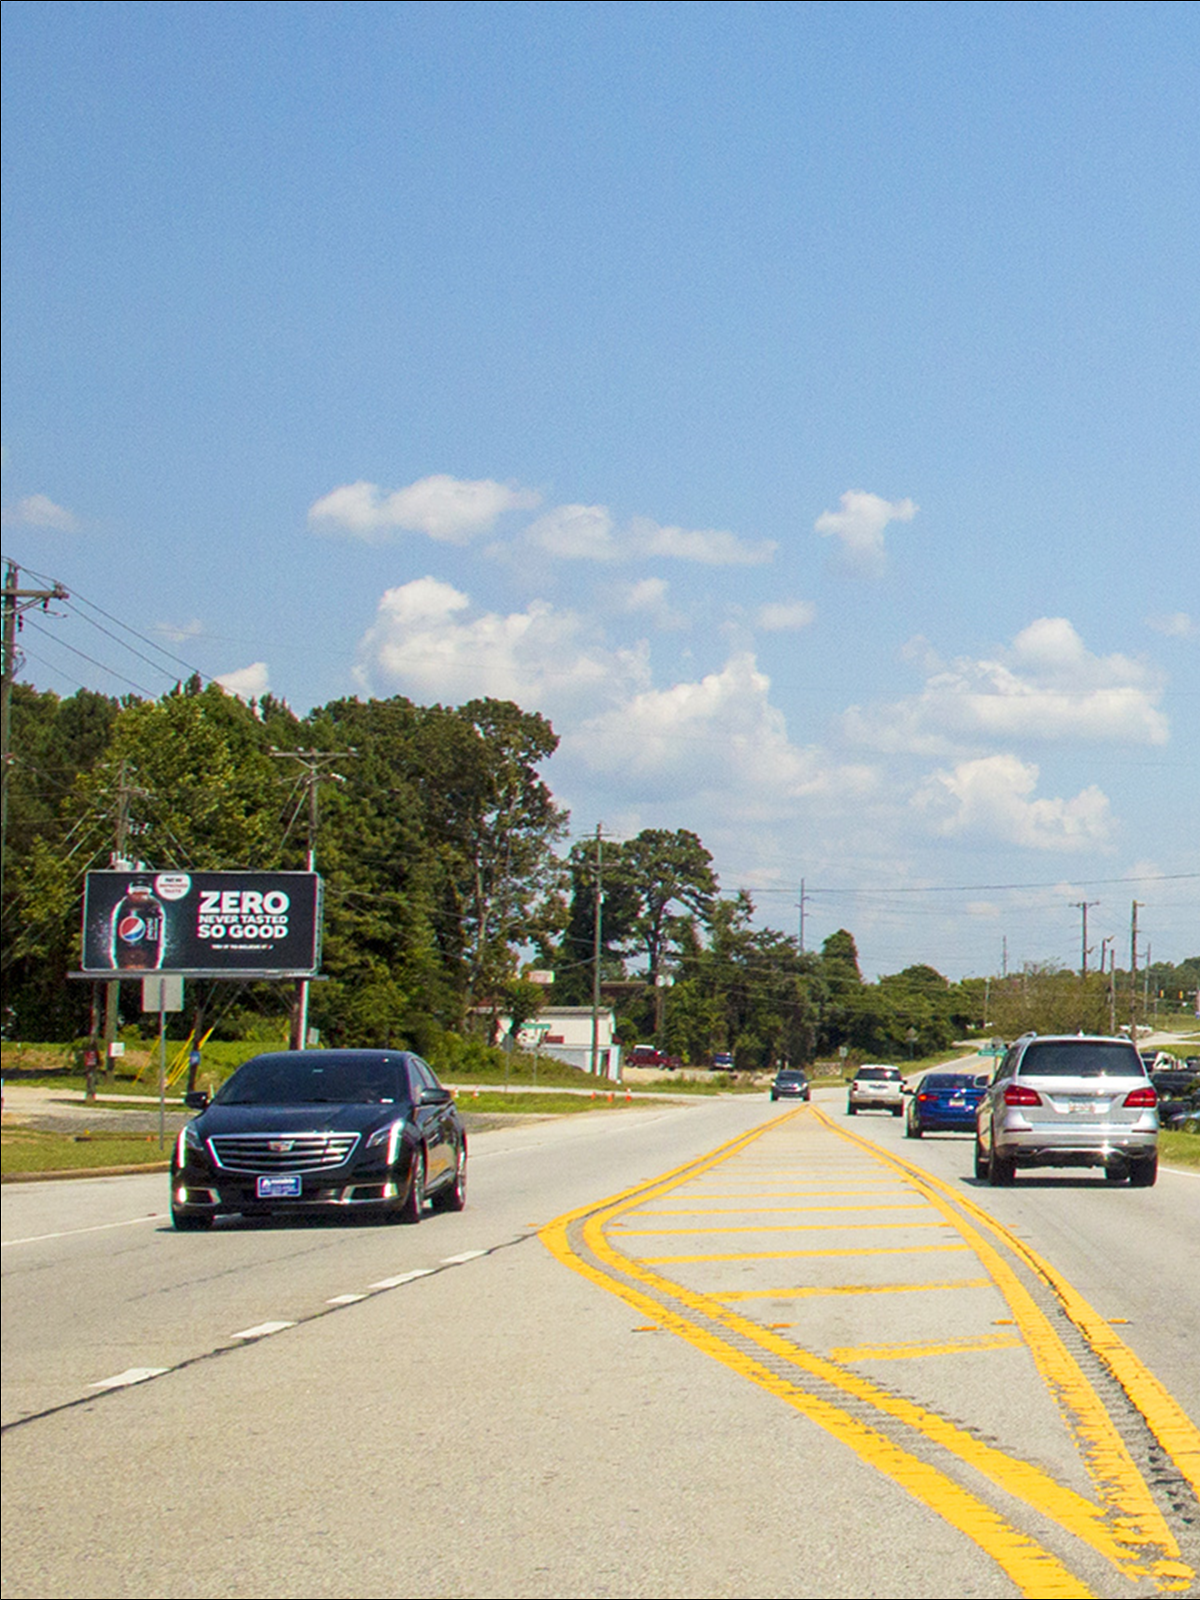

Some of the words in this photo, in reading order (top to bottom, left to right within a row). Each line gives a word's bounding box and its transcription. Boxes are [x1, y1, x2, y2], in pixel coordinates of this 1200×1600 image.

[199, 890, 290, 915] ZERO
[198, 914, 239, 924] NEVER
[240, 914, 289, 924] TASTED
[197, 924, 226, 939] SO
[228, 924, 289, 939] GOOD
